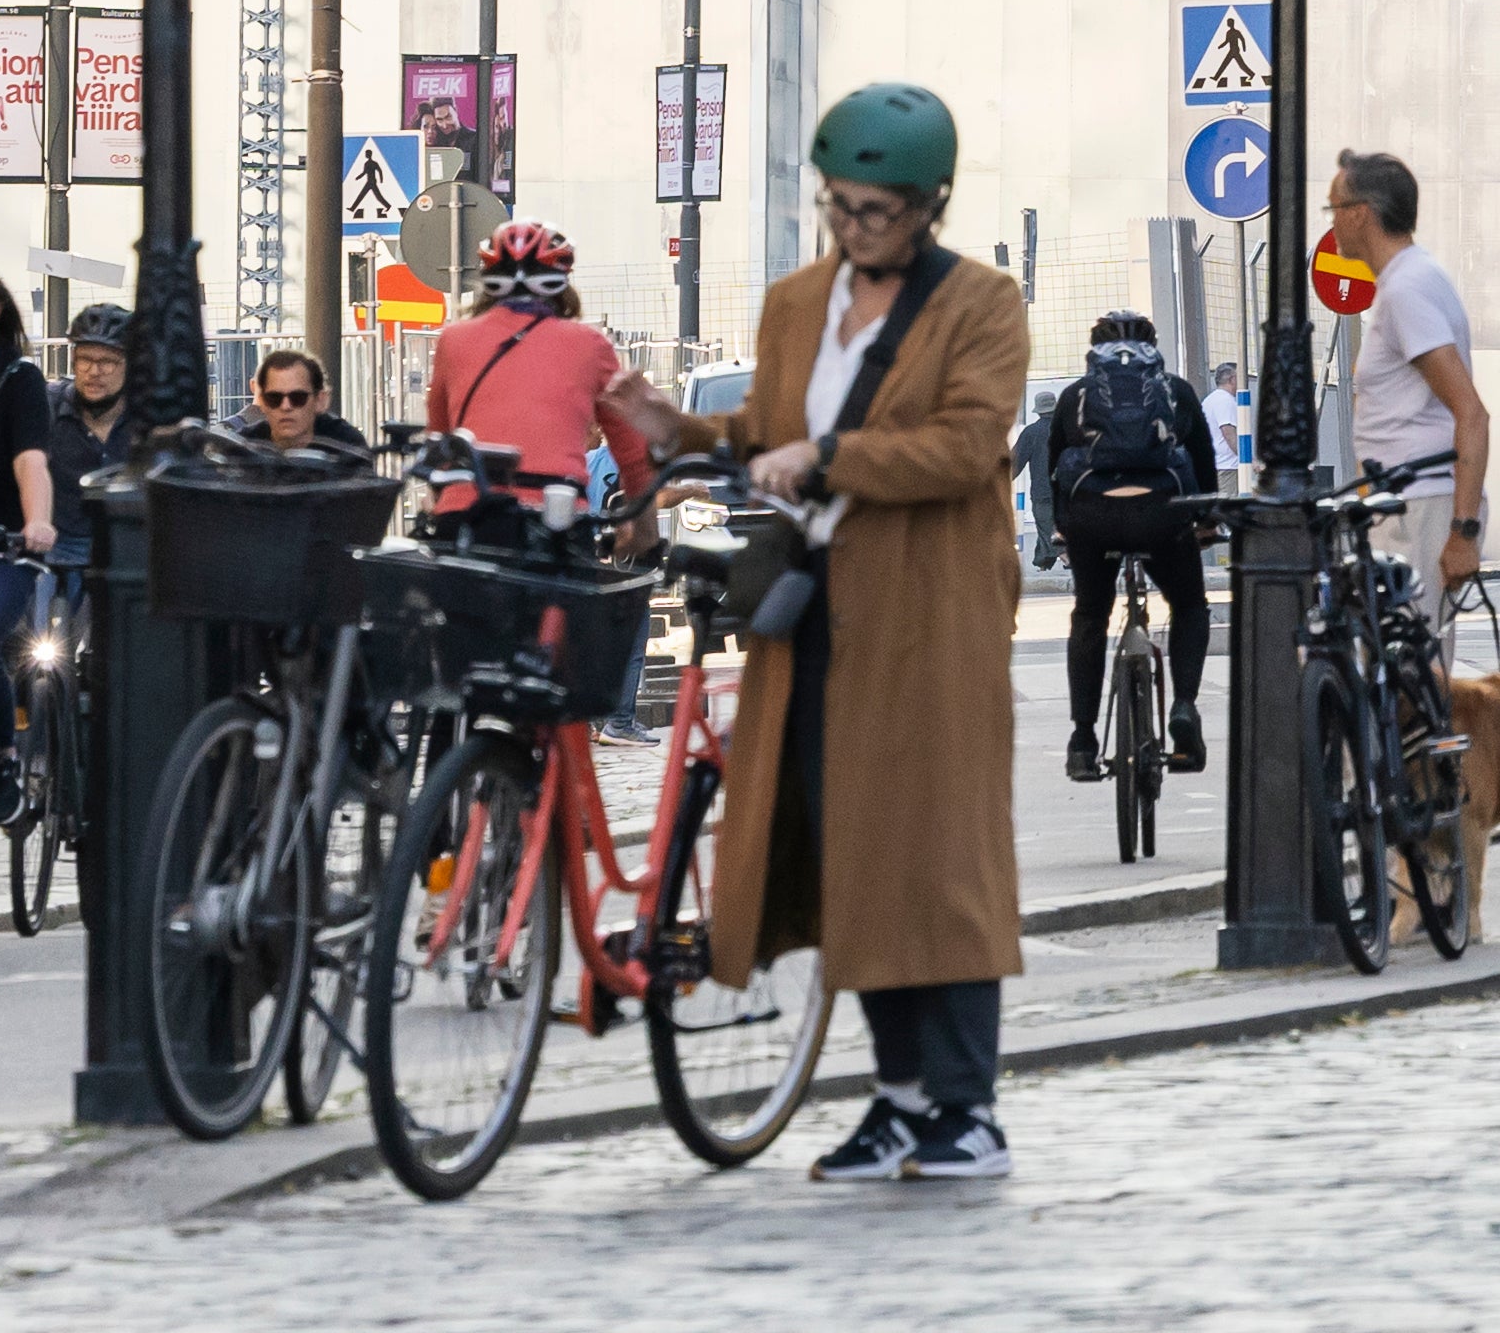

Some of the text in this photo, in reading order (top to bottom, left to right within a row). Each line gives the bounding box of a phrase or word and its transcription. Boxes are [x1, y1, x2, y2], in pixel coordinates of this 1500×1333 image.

[101, 9, 142, 18] kulturrek
[77, 47, 144, 75] Pens
[5, 79, 44, 104] att
[76, 75, 142, 103] värd
[417, 77, 463, 96] FEJK
[658, 98, 684, 120] Pensio
